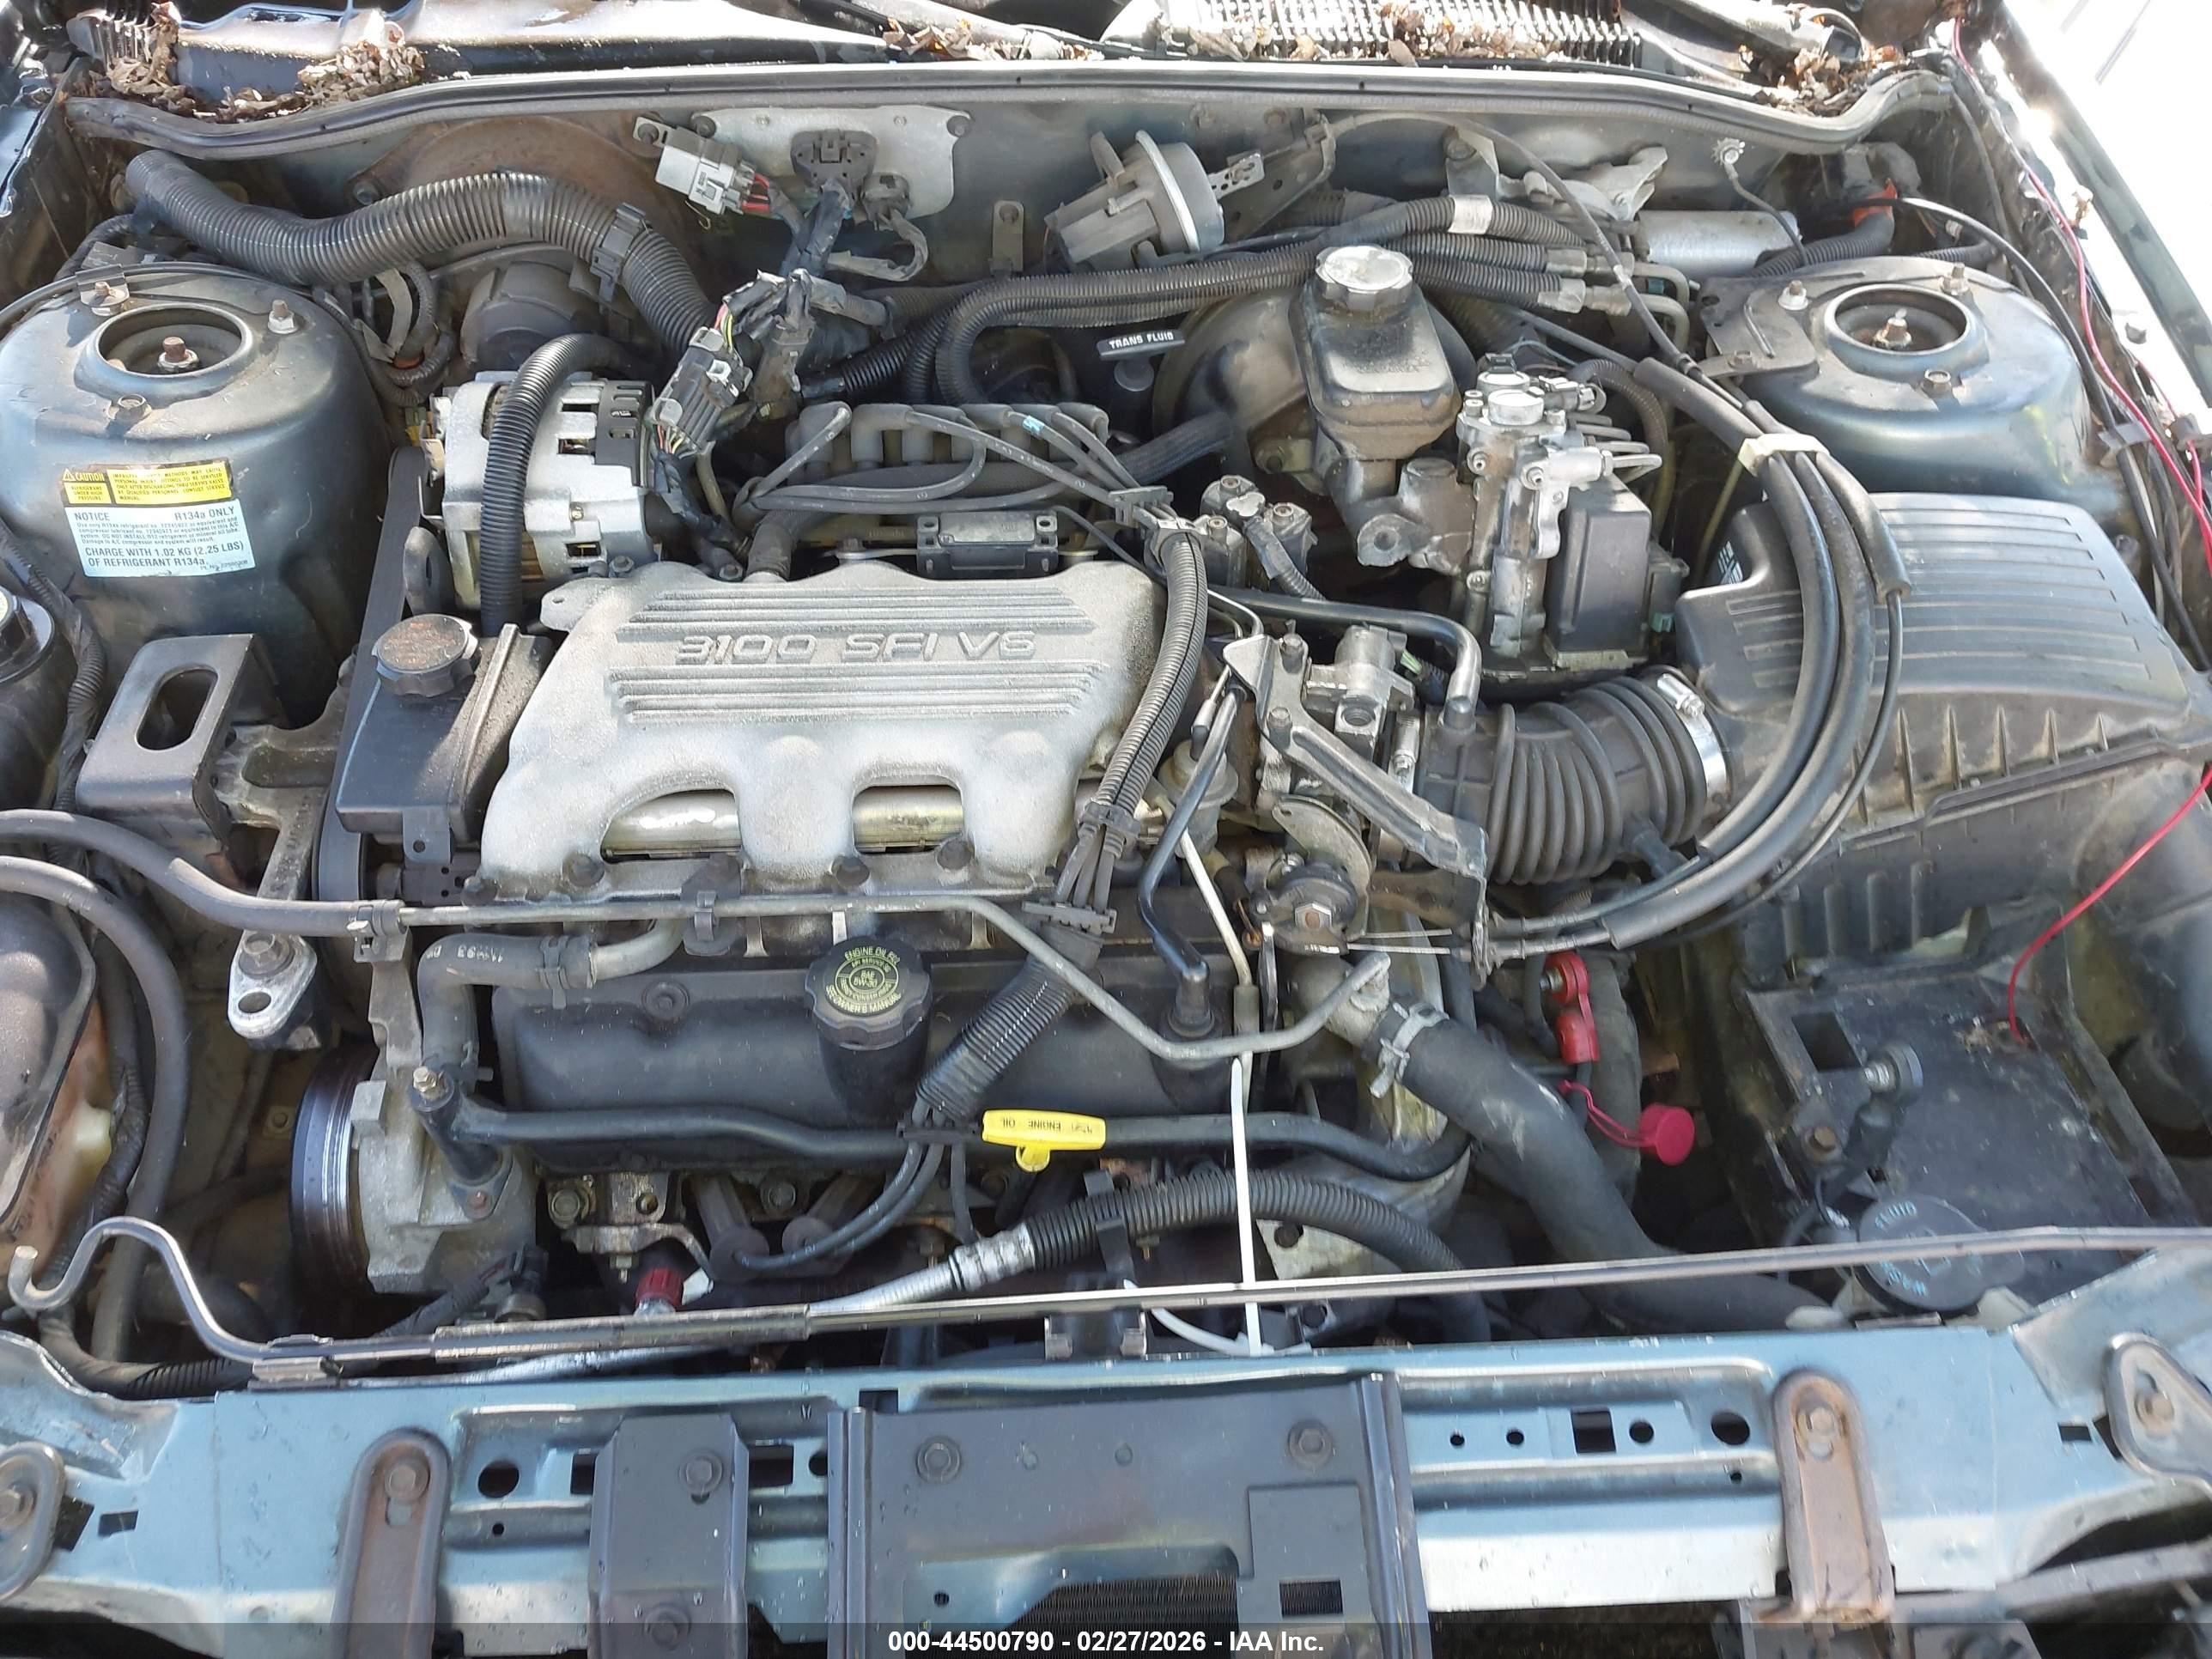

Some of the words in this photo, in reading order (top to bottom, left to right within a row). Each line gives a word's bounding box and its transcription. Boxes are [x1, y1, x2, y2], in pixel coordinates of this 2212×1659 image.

[1109, 334, 1144, 349] TRANS
[1146, 331, 1174, 343] FLUID
[75, 472, 105, 482] CAUTION
[74, 512, 110, 521] NOTICE
[174, 509, 206, 521] R134a
[209, 506, 234, 519] ONLY
[85, 546, 125, 557] CHARGE
[126, 547, 151, 557] WITH
[155, 547, 176, 556] 1.02
[178, 546, 191, 556] KG
[193, 544, 220, 556] (2.25
[222, 540, 245, 551] LBS)
[88, 557, 100, 567] OF
[104, 556, 173, 567] REFRIGERANT
[676, 633, 819, 665] 3100
[841, 631, 939, 662] SFI
[957, 630, 1036, 660] V6
[844, 945, 873, 961] ENGINE
[869, 992, 902, 1013] MANUAL
[1002, 1117, 1016, 1128] OIL
[1028, 1119, 1061, 1132] ENGINE
